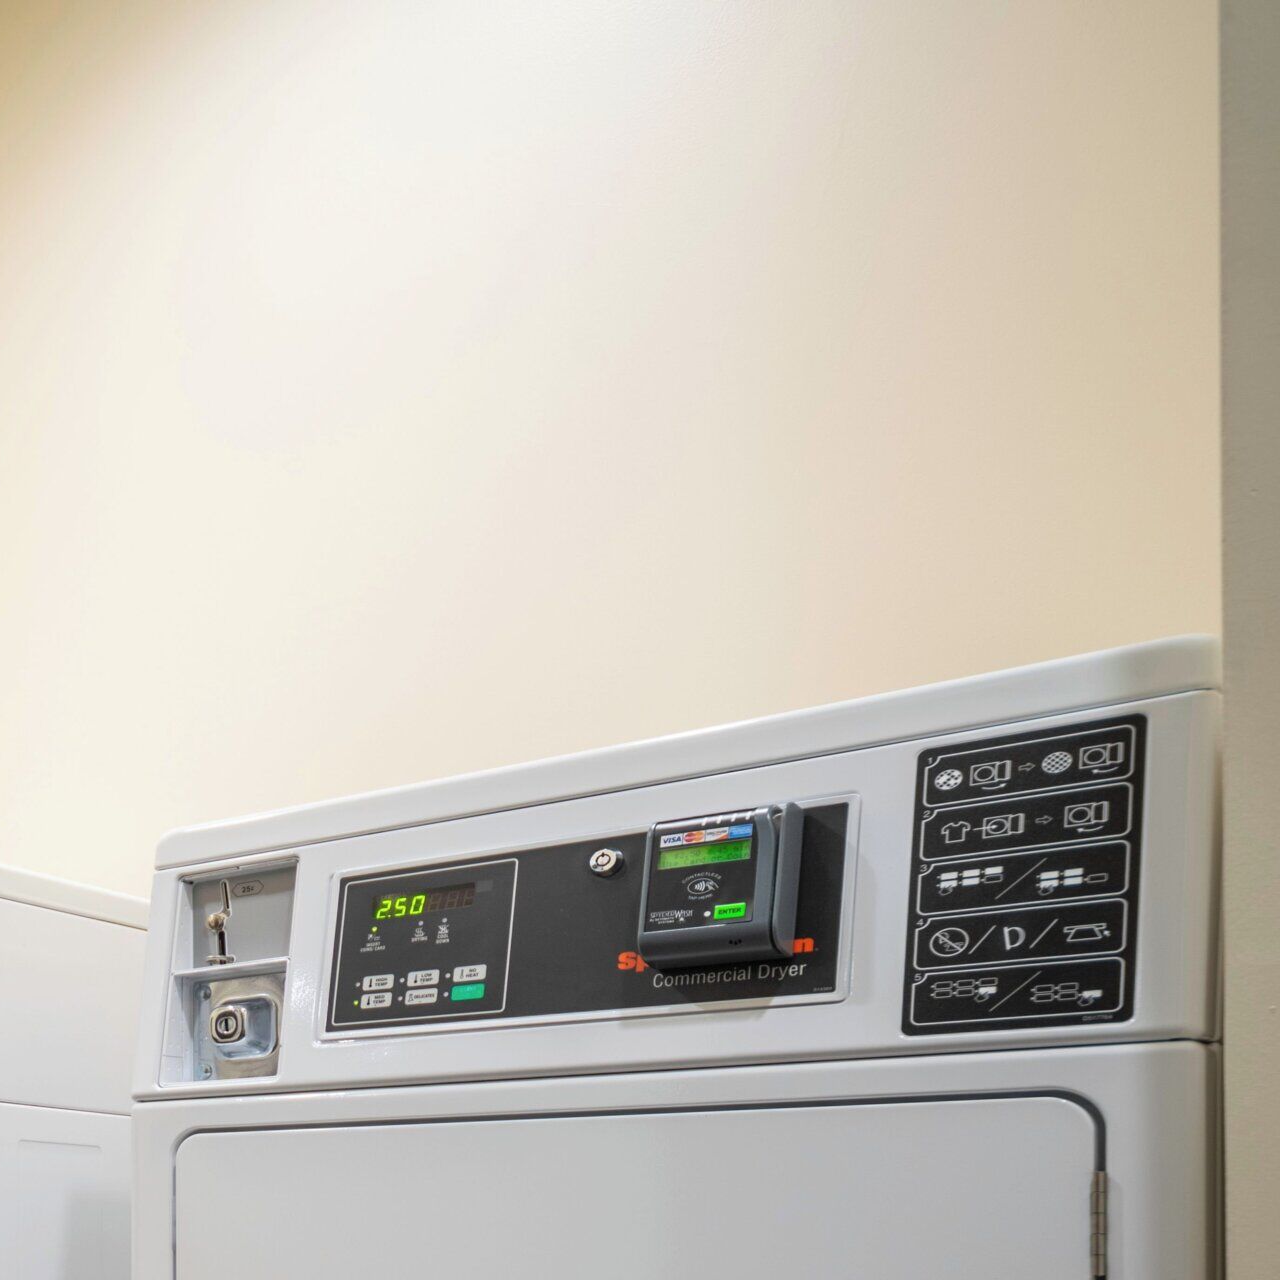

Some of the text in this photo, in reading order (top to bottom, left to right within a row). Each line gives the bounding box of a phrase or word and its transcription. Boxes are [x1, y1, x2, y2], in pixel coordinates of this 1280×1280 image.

[663, 835, 682, 844] VISA
[682, 871, 722, 884] CONTACTLESS
[375, 894, 426, 919] 2.50
[718, 907, 742, 915] ENTER
[652, 961, 807, 989] Commercial Dryer
